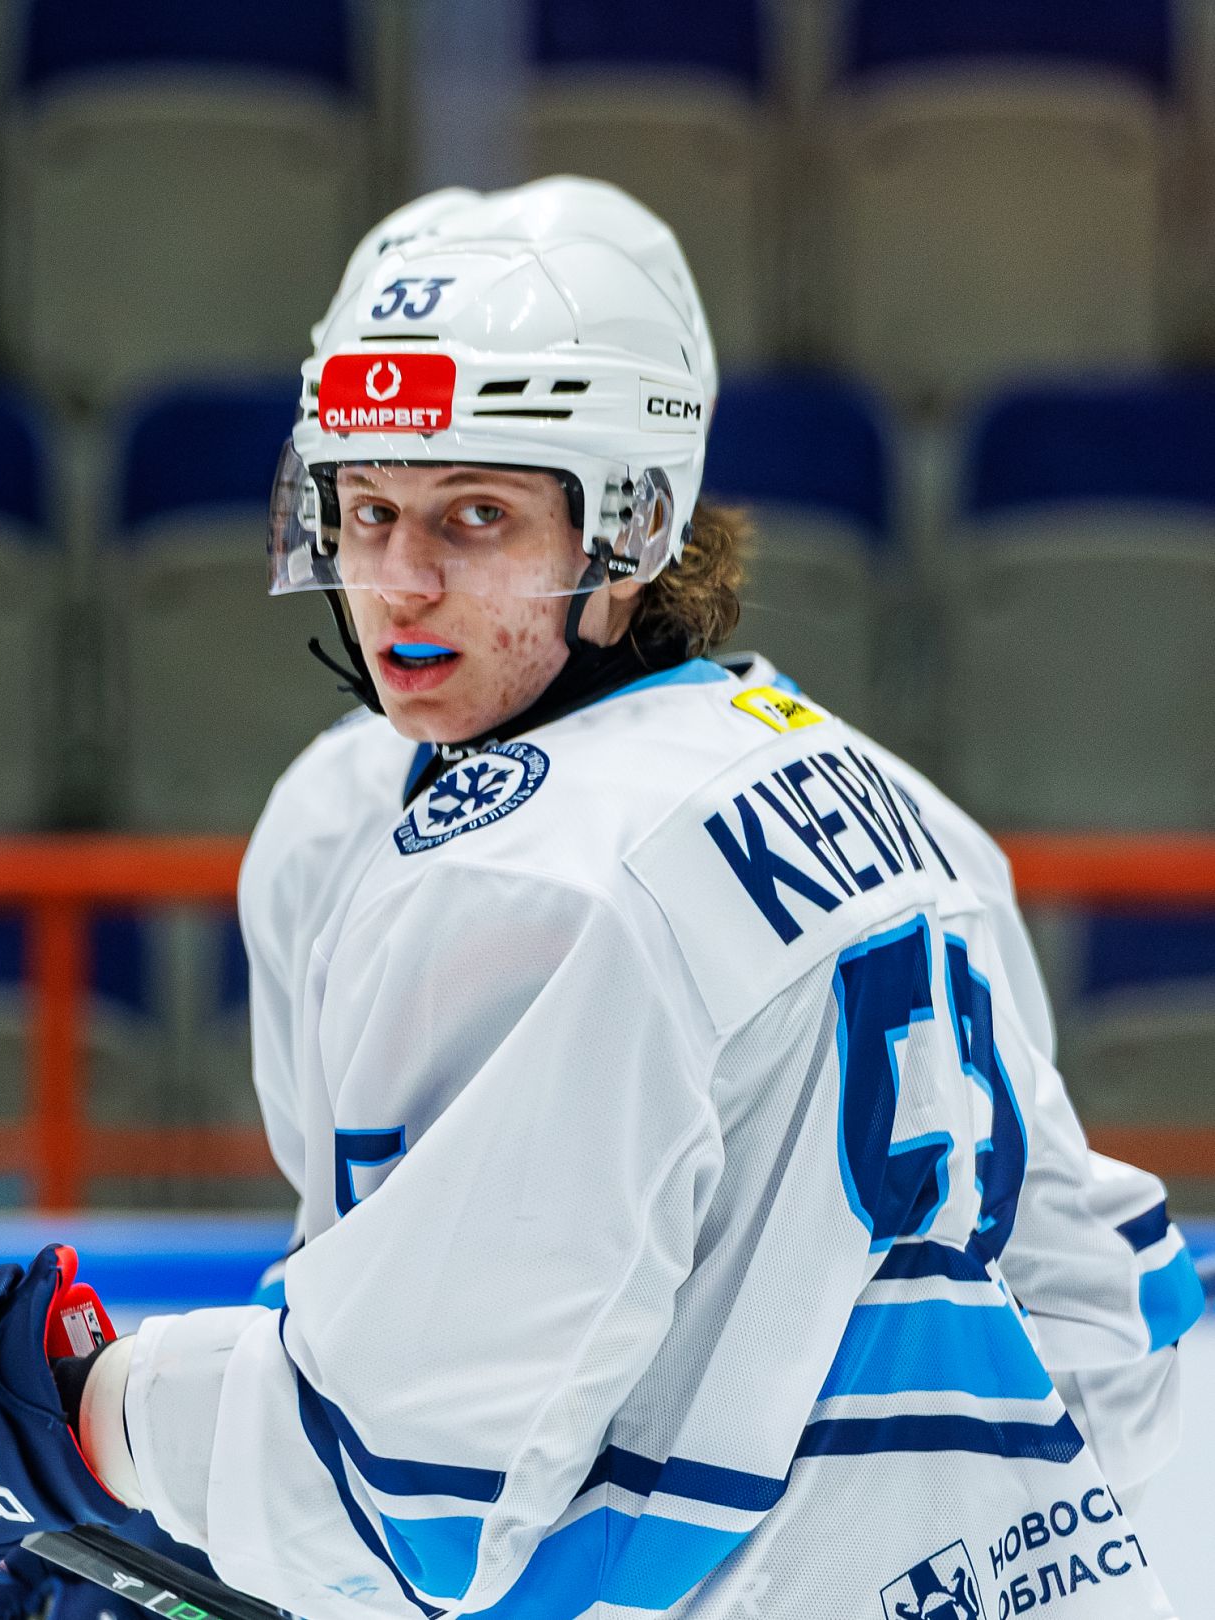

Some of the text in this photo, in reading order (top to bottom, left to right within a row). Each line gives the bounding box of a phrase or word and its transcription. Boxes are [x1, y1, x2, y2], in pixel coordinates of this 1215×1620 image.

[372, 277, 456, 320] 53
[325, 407, 443, 427] OLIMPBET
[647, 396, 701, 421] CCM
